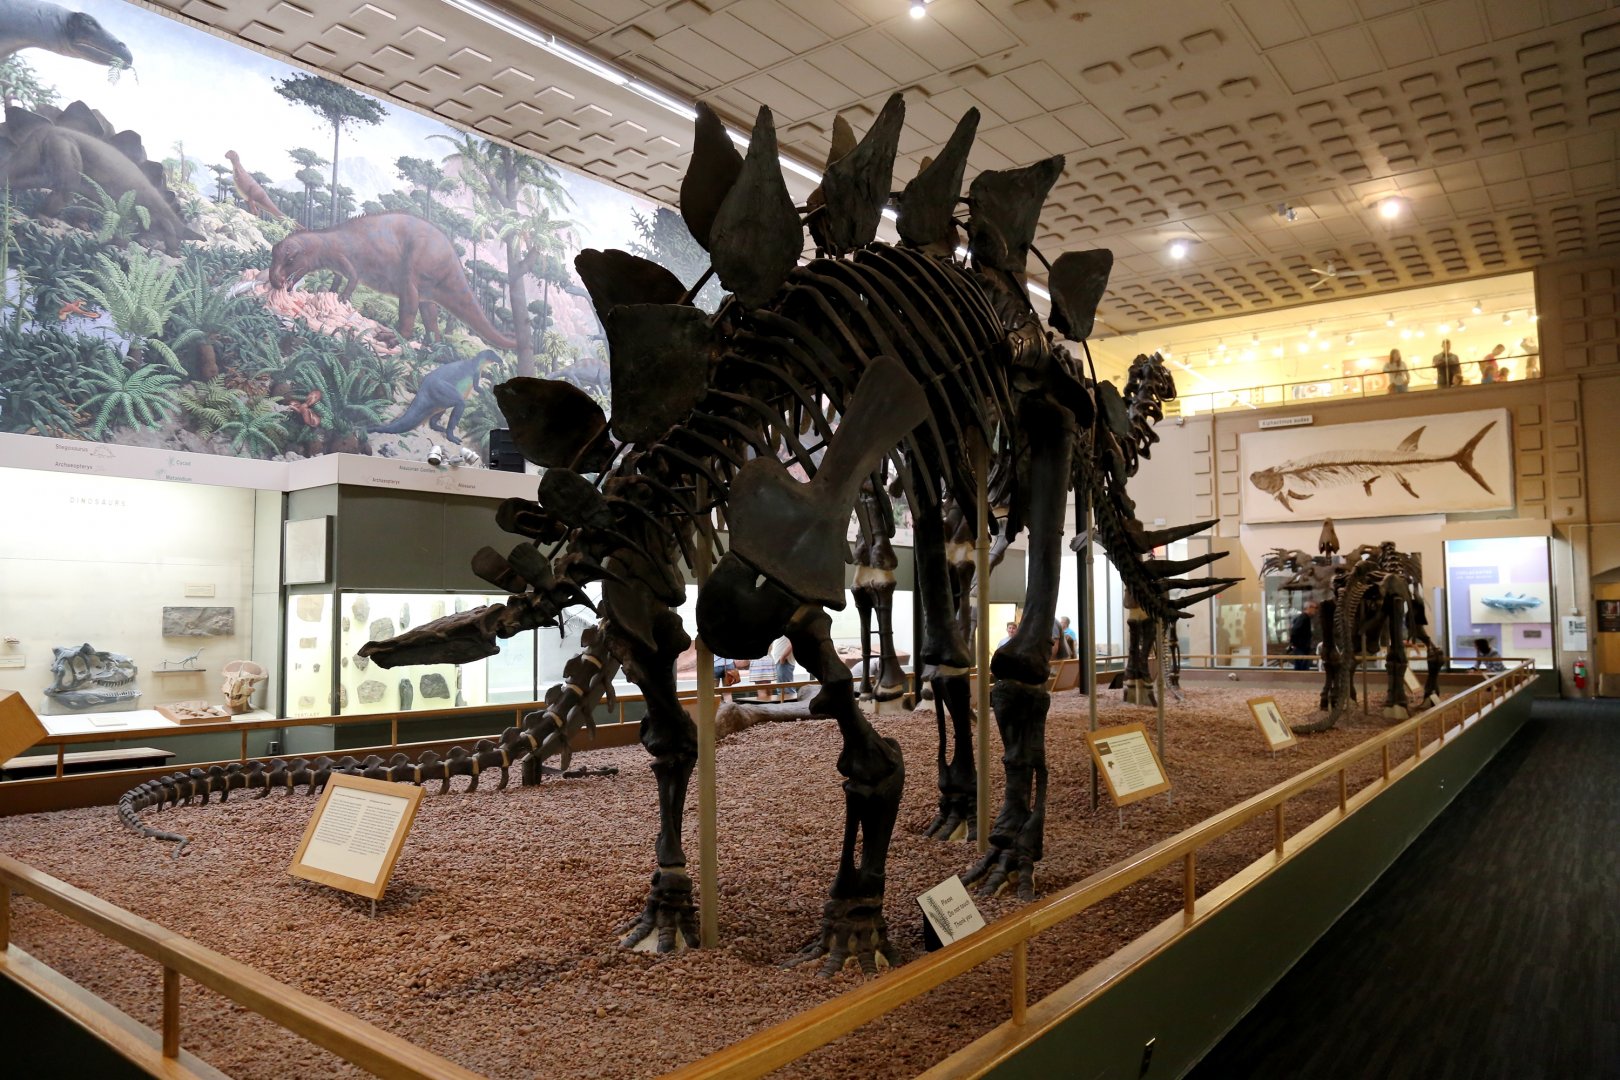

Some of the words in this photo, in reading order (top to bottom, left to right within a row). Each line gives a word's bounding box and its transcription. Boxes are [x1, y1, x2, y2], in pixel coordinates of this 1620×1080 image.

[55, 443, 88, 453] Stegosaurus
[55, 461, 93, 470] Archaeopteryx
[69, 496, 126, 507] DINOSAURS
